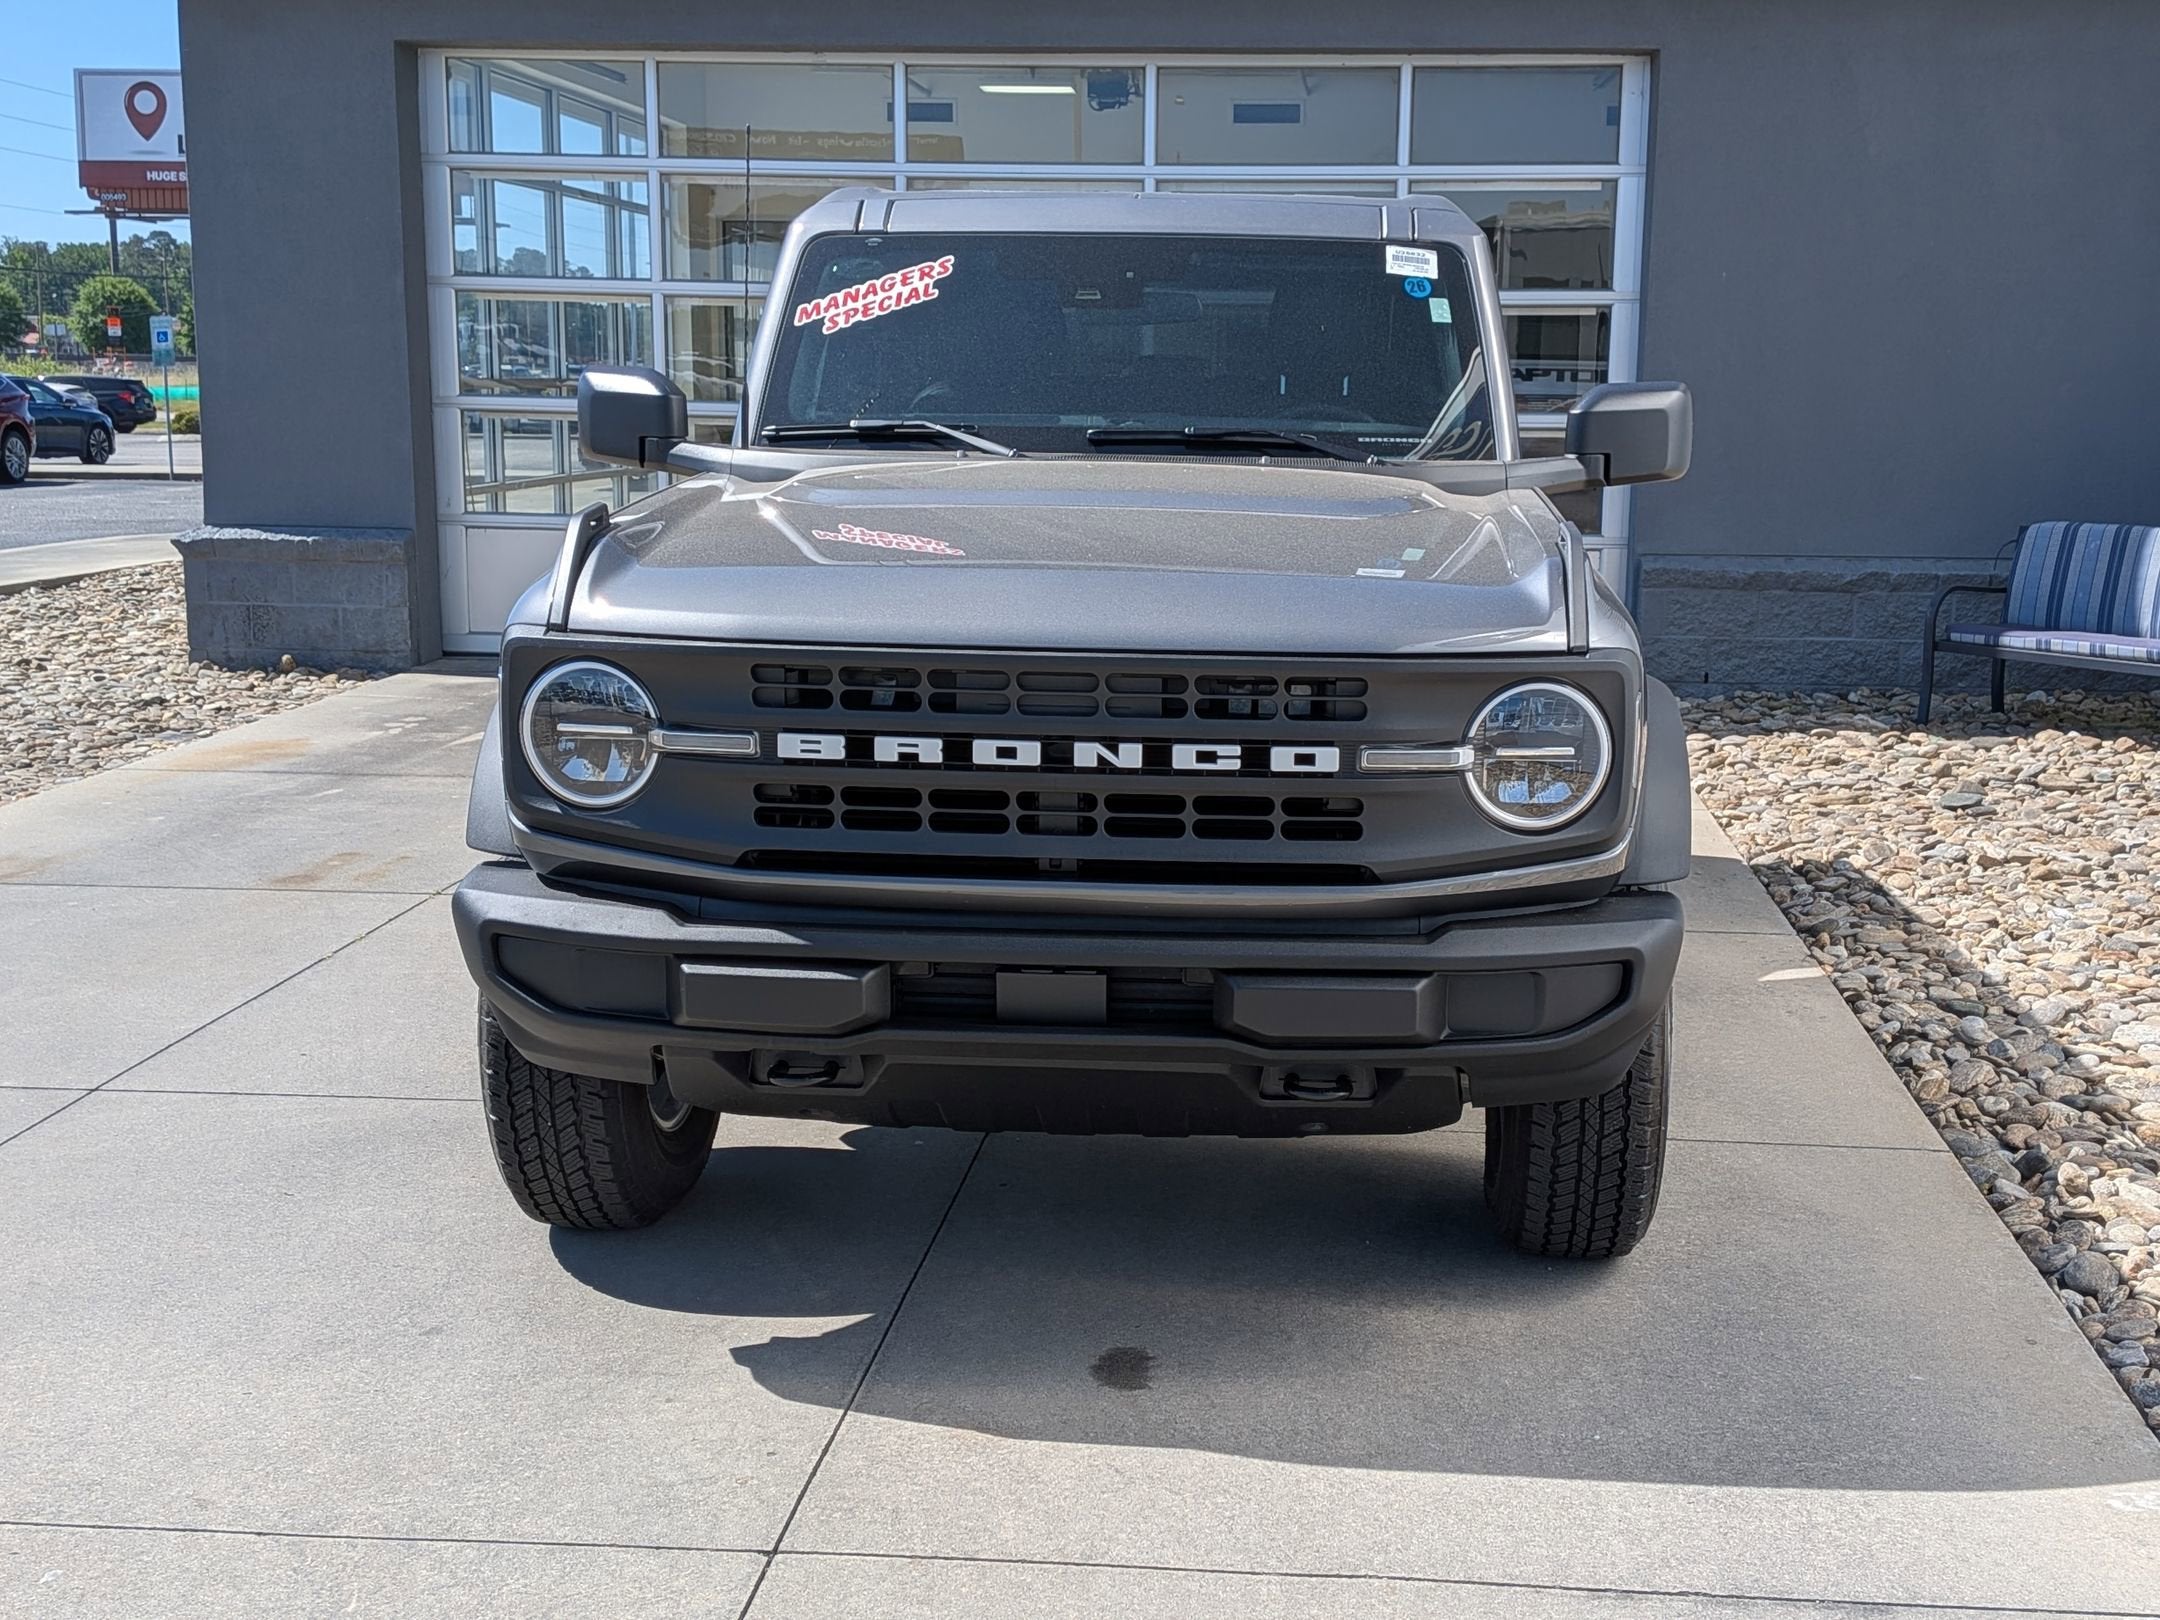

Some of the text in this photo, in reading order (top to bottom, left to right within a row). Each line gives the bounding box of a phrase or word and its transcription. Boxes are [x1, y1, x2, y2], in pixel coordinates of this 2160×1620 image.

[146, 170, 177, 181] HUGE
[796, 256, 953, 324] MANAGERS
[1406, 280, 1427, 294] 26
[824, 282, 937, 333] SPECIAL
[1510, 367, 1608, 383] APTO
[776, 731, 1340, 773] BRONCO
